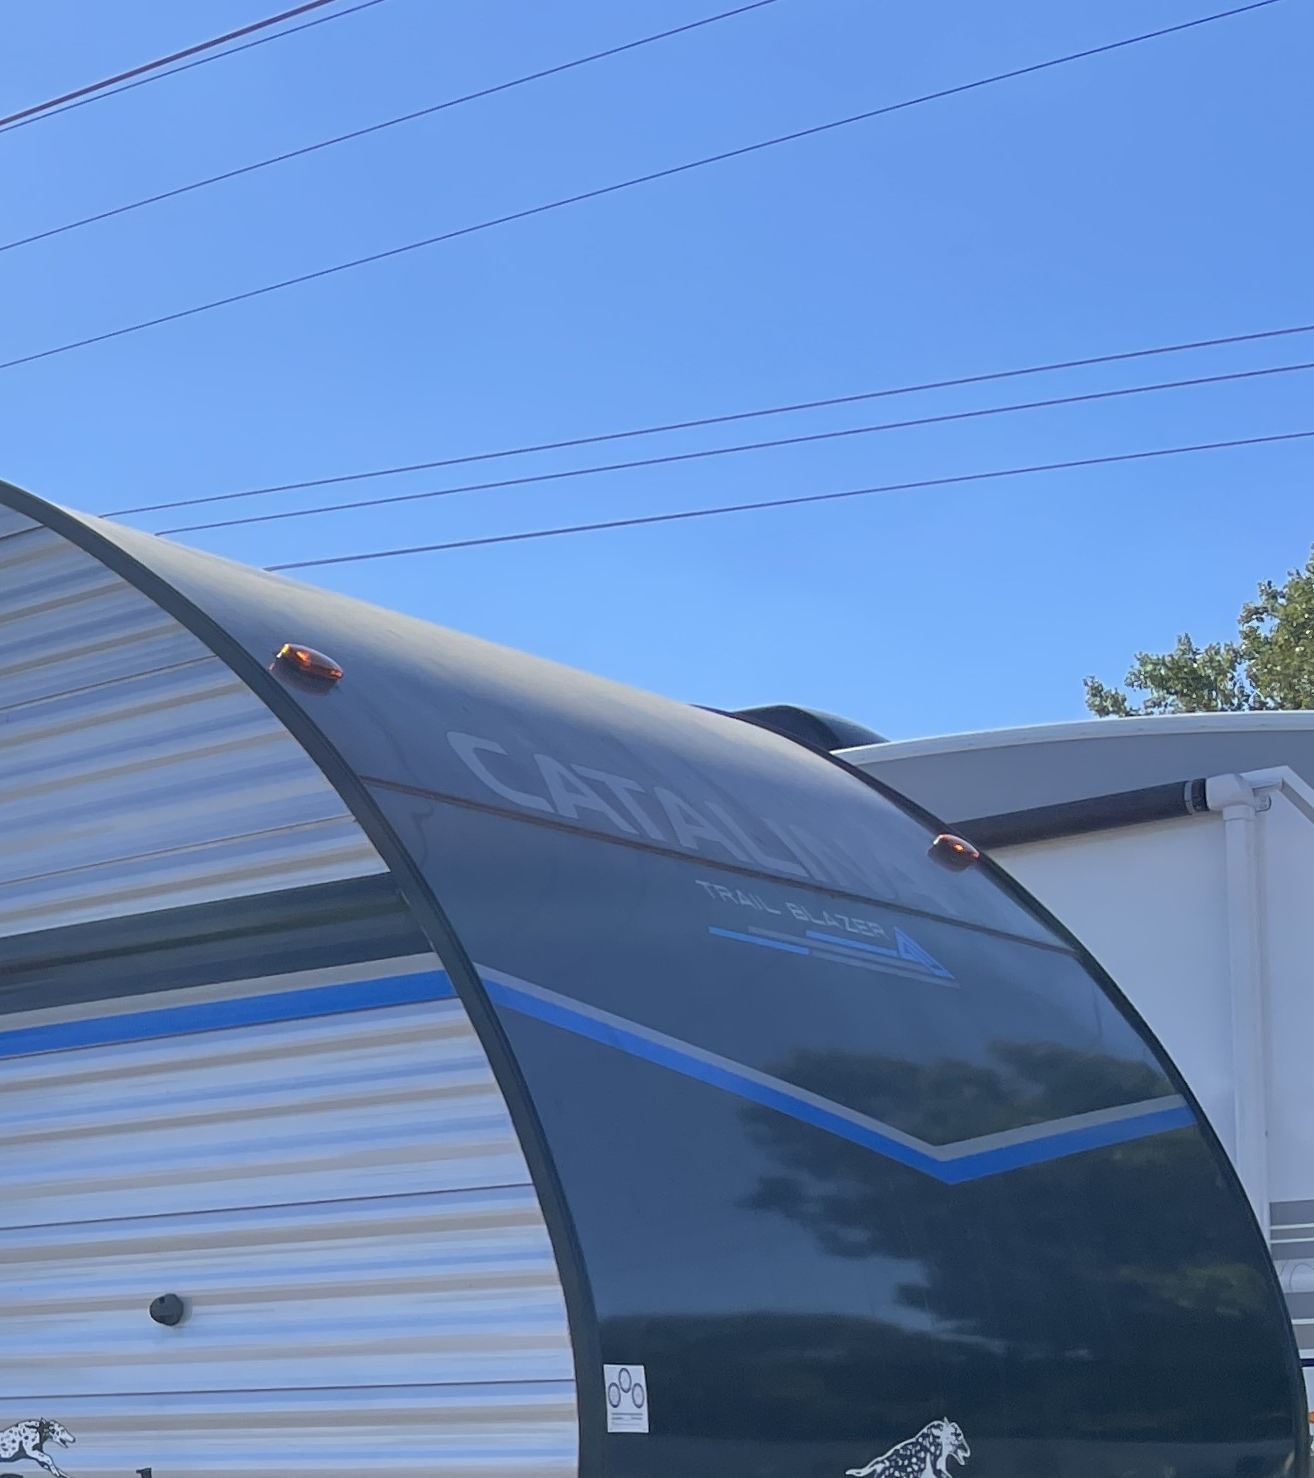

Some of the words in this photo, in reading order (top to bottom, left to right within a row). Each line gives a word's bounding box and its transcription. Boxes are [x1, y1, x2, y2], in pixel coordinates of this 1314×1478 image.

[446, 731, 953, 915] CATALINA
[694, 879, 781, 915] TRAIL
[785, 902, 890, 940] BLAZER
